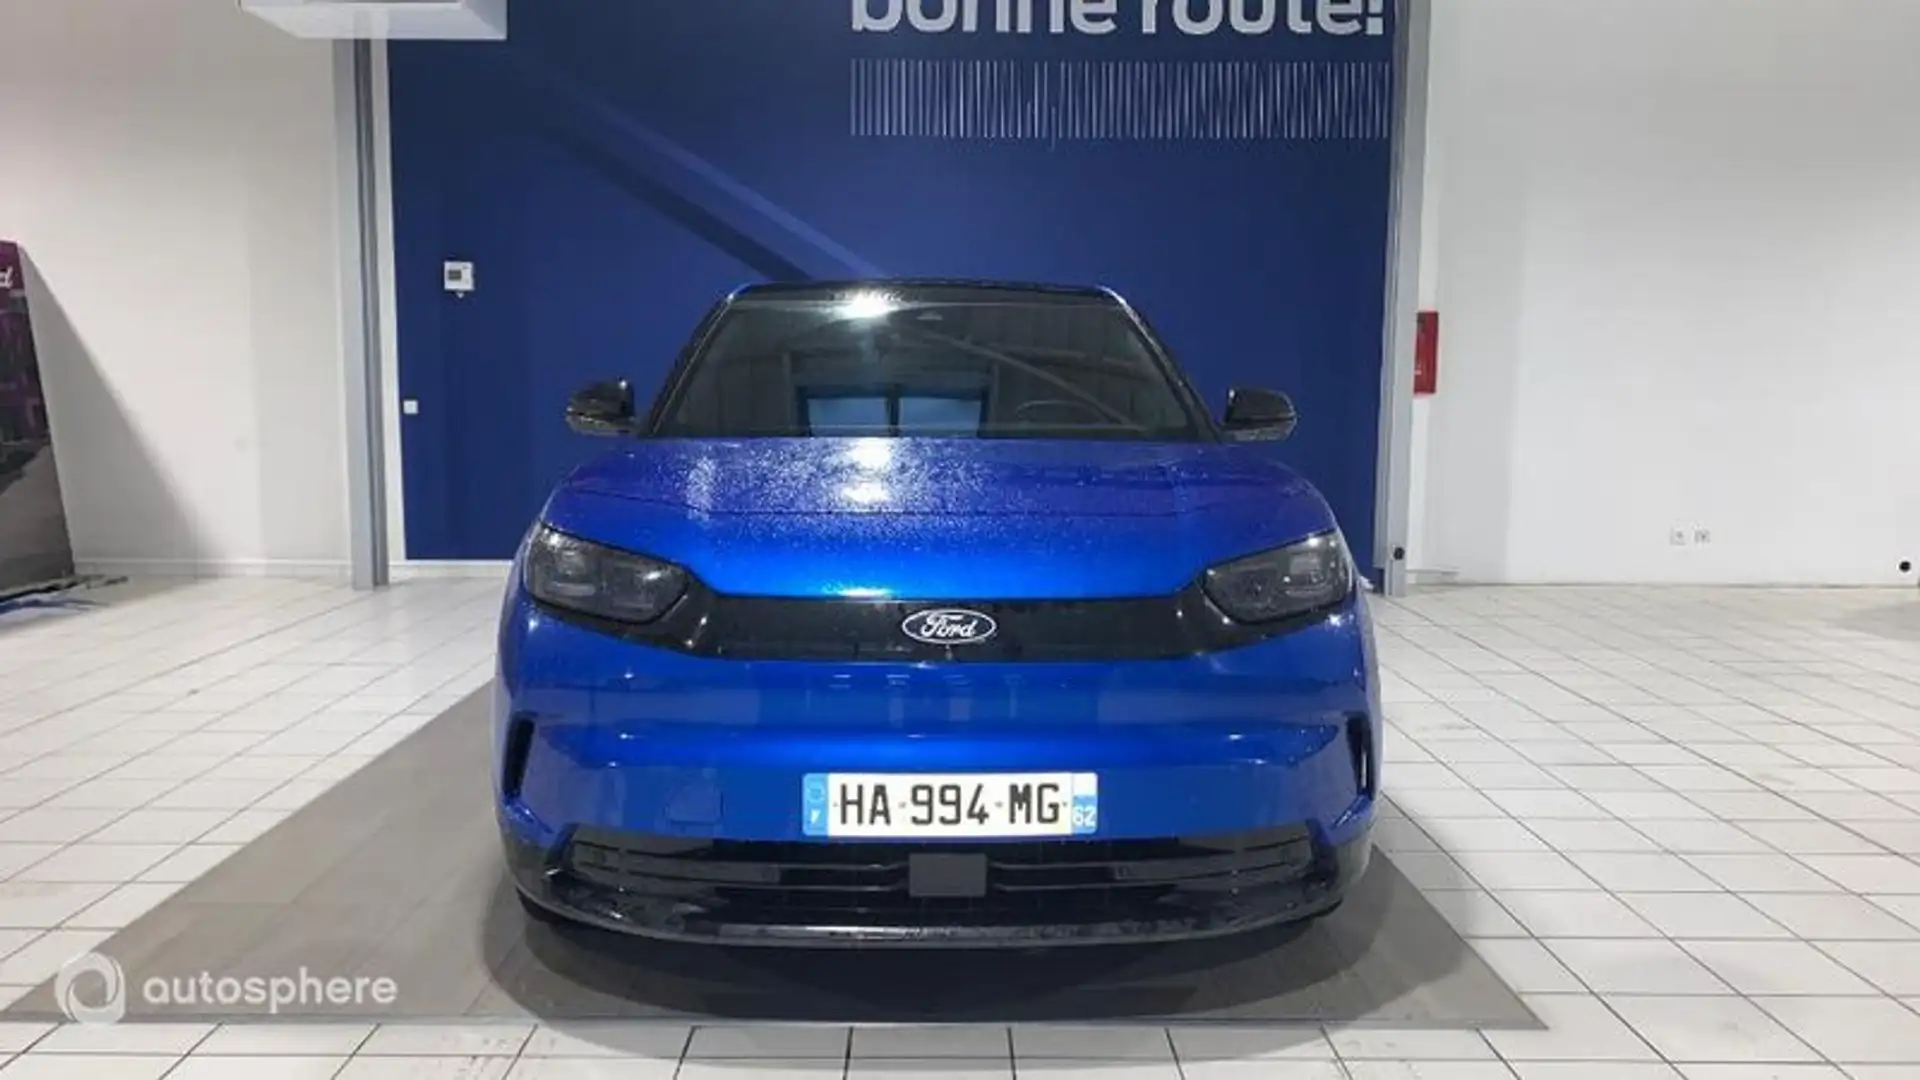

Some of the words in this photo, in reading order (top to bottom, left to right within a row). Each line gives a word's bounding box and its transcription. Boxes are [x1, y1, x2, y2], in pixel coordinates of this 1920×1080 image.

[852, 0, 1118, 34] bonne
[920, 613, 978, 637] Ford
[1073, 805, 1097, 828] 62
